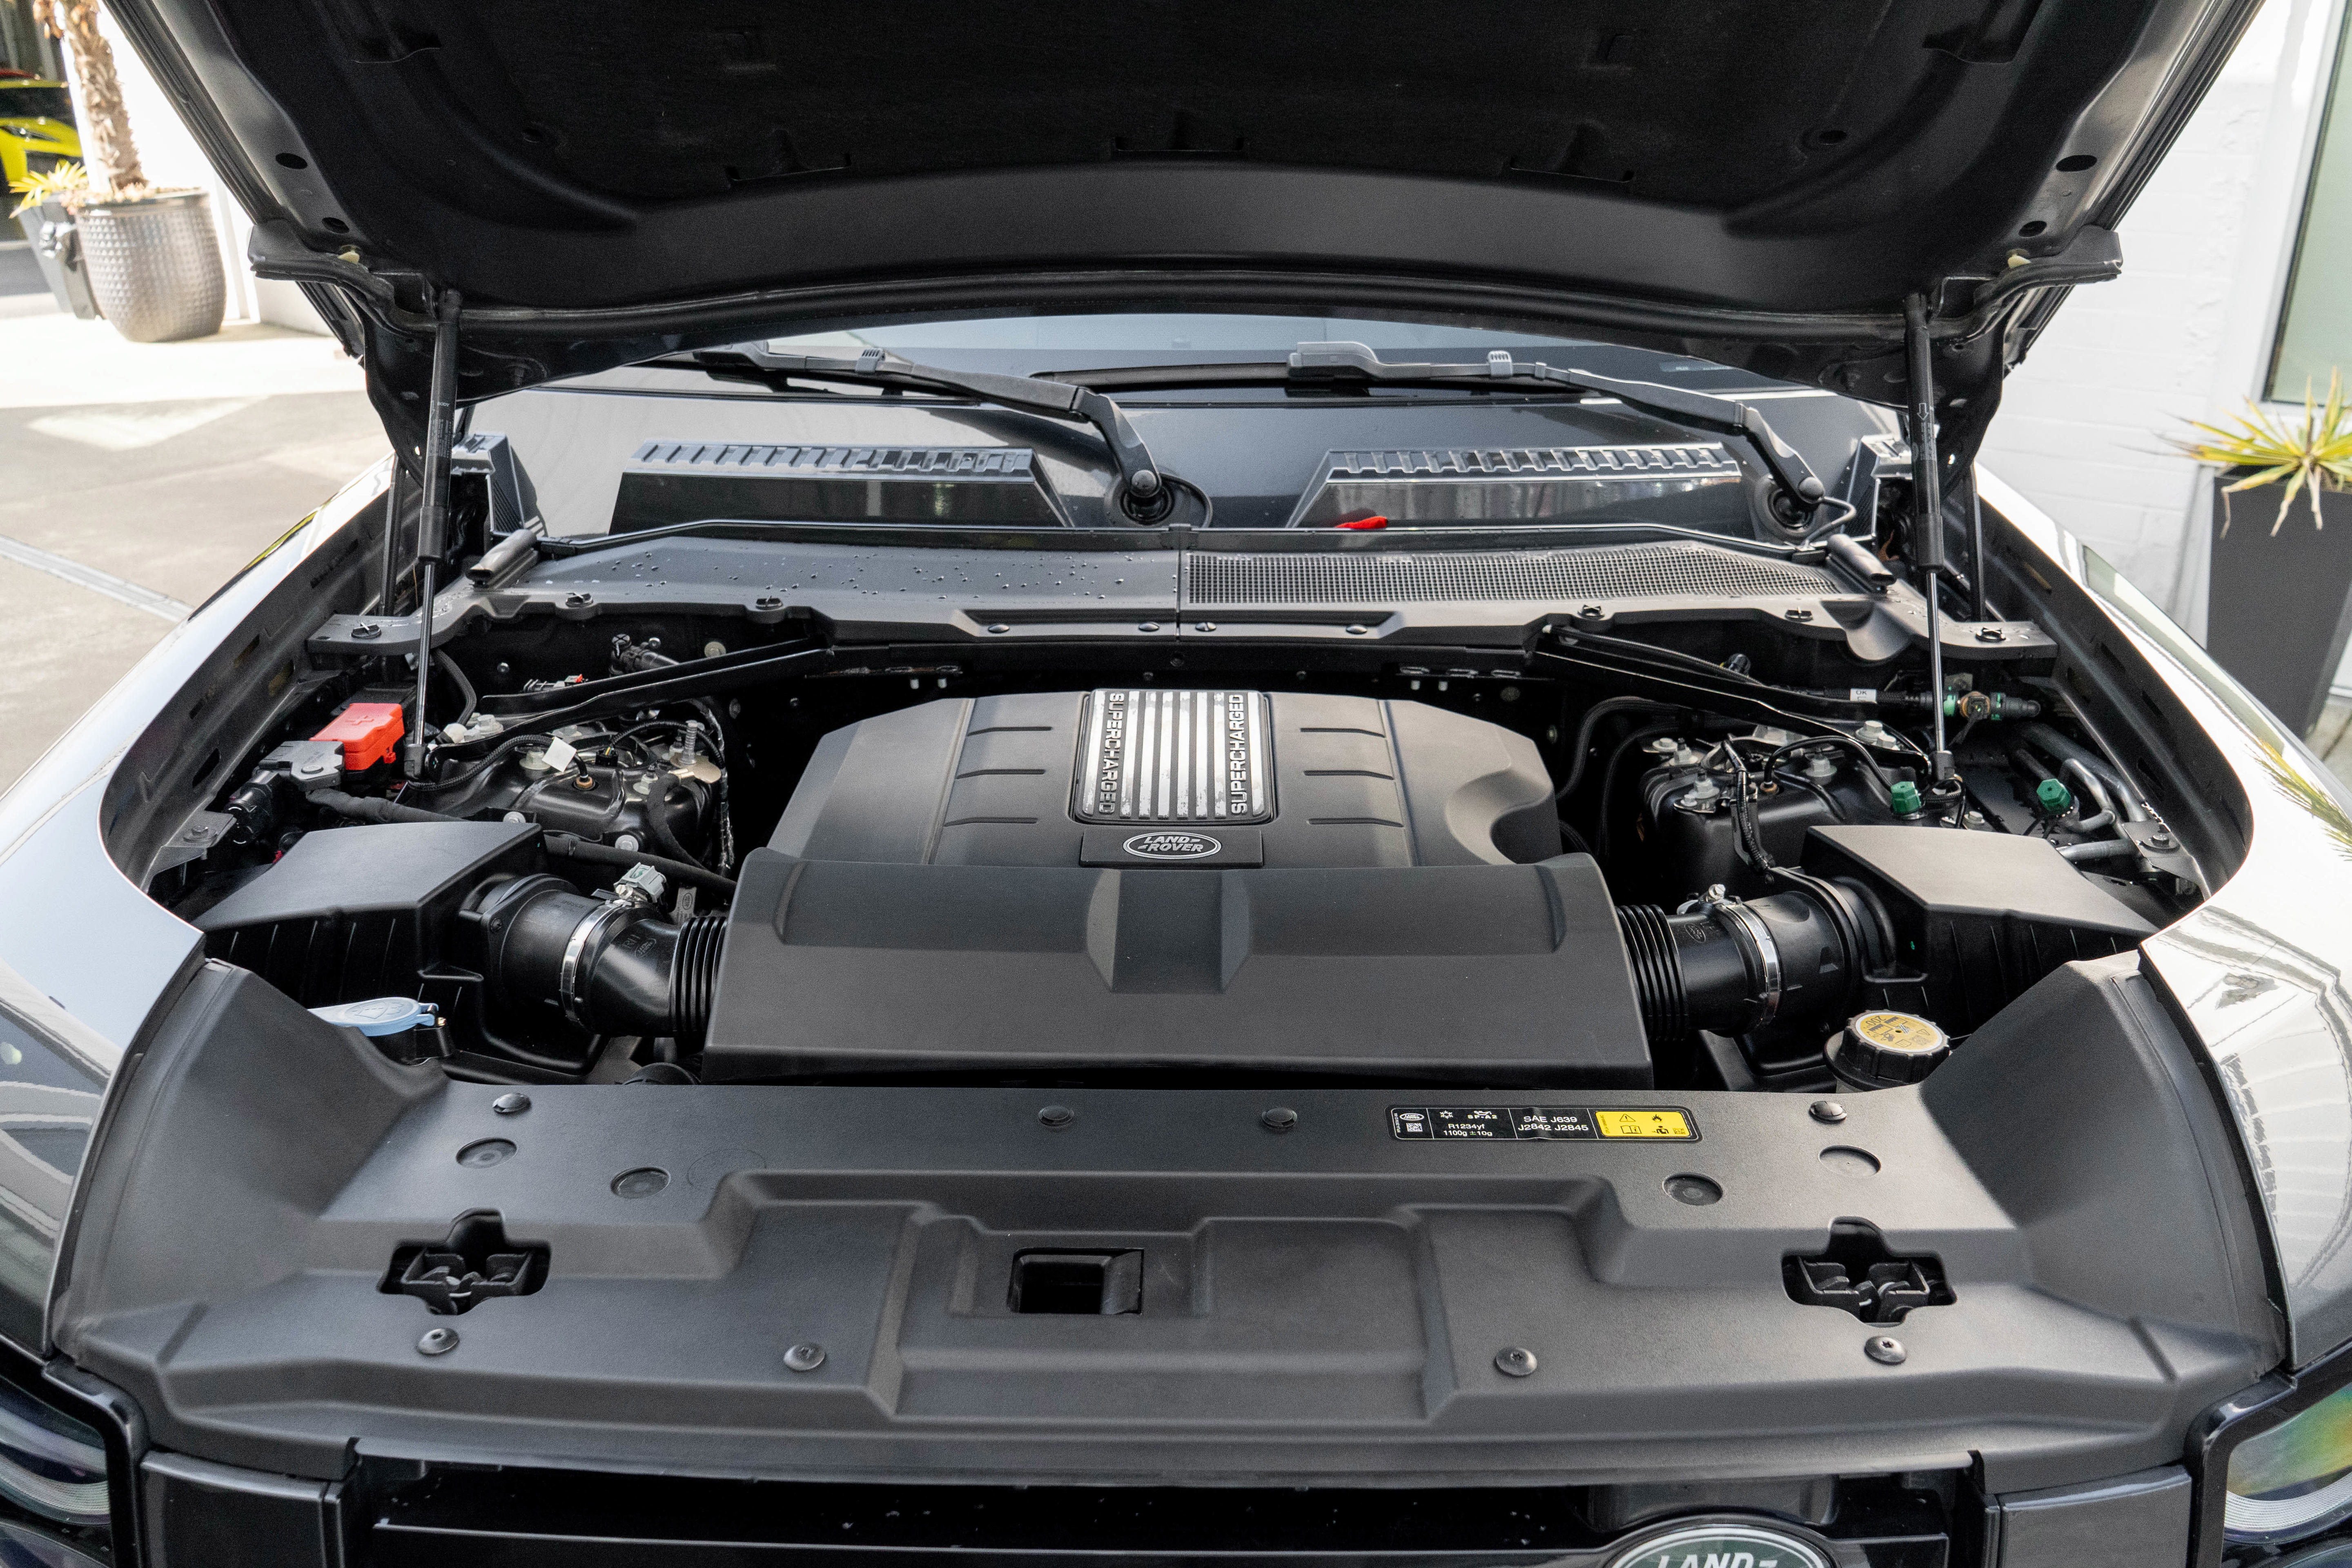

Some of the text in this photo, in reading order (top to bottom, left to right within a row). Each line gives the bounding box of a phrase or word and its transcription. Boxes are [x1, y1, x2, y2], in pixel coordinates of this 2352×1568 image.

[1099, 692, 1125, 814] SUPERCHARGED
[1228, 694, 1247, 815] SUPERCHARGED
[1148, 844, 1204, 852] ROVER
[1866, 1016, 1886, 1025] 200
